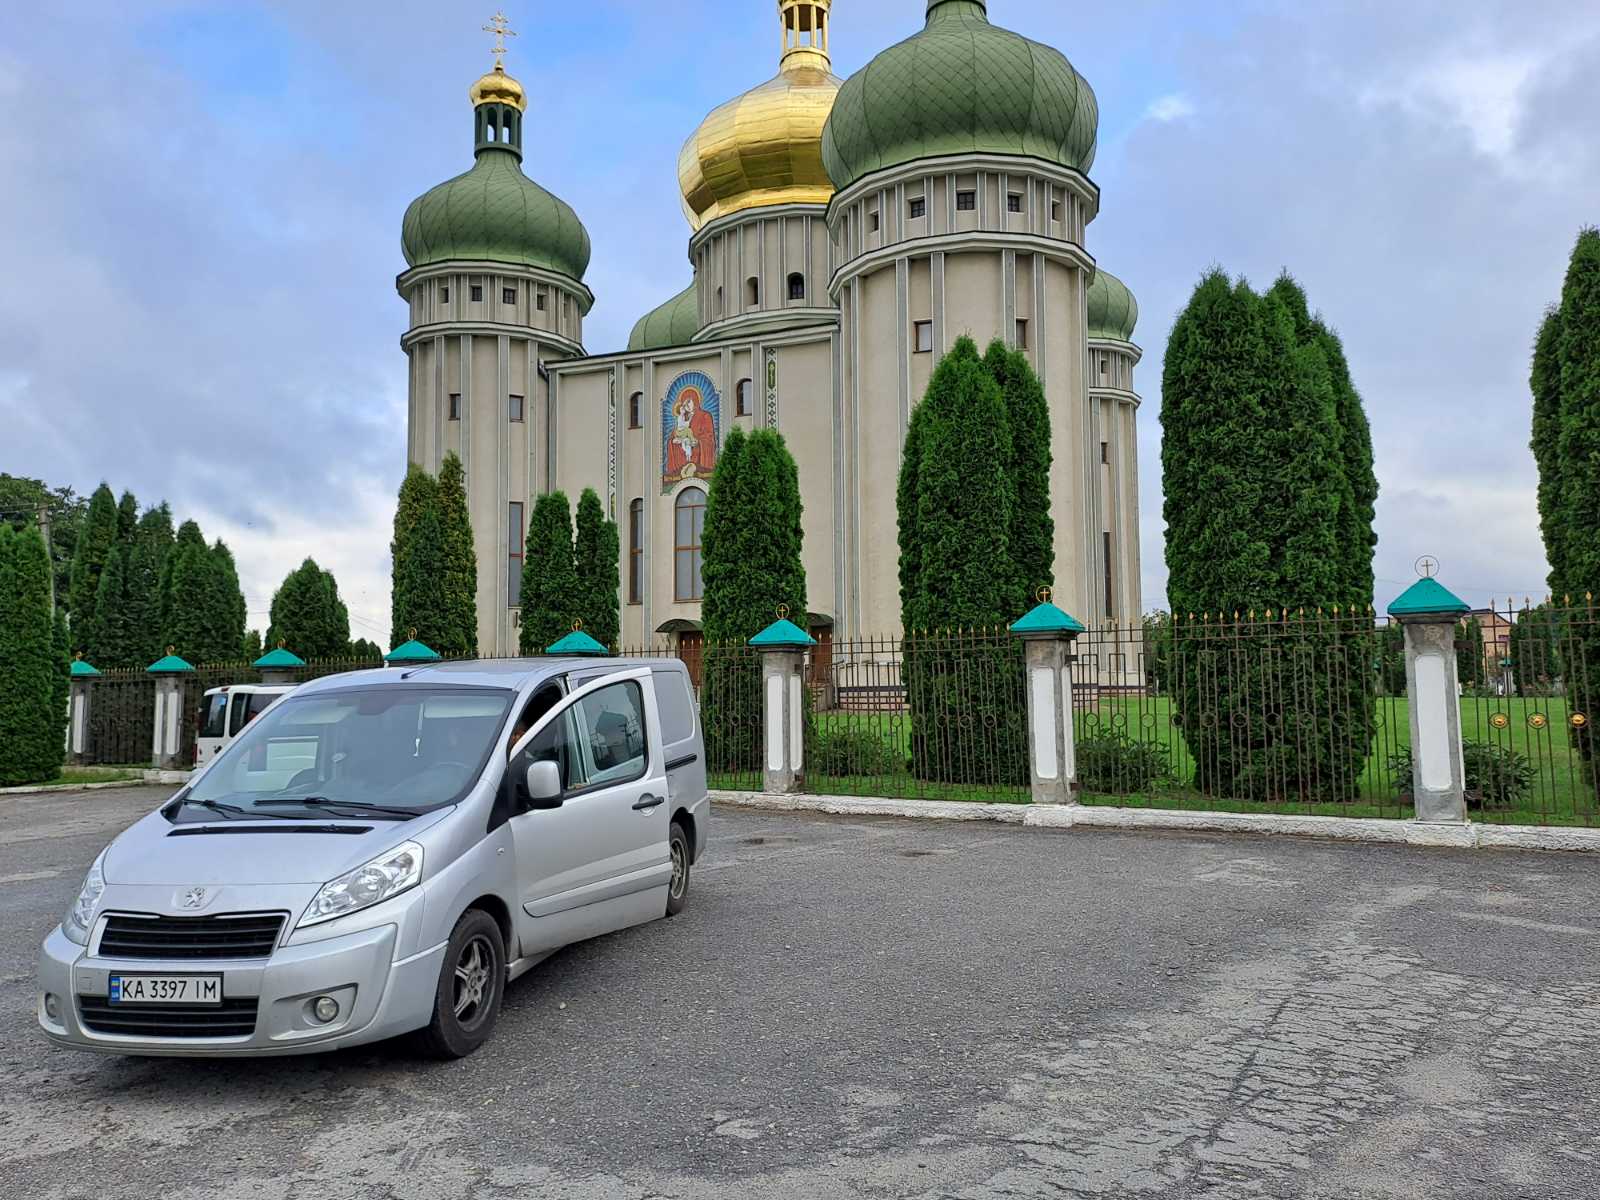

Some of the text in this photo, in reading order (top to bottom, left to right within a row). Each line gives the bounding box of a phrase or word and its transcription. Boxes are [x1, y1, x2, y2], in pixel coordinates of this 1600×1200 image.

[122, 980, 216, 999] KA 3397 IM
